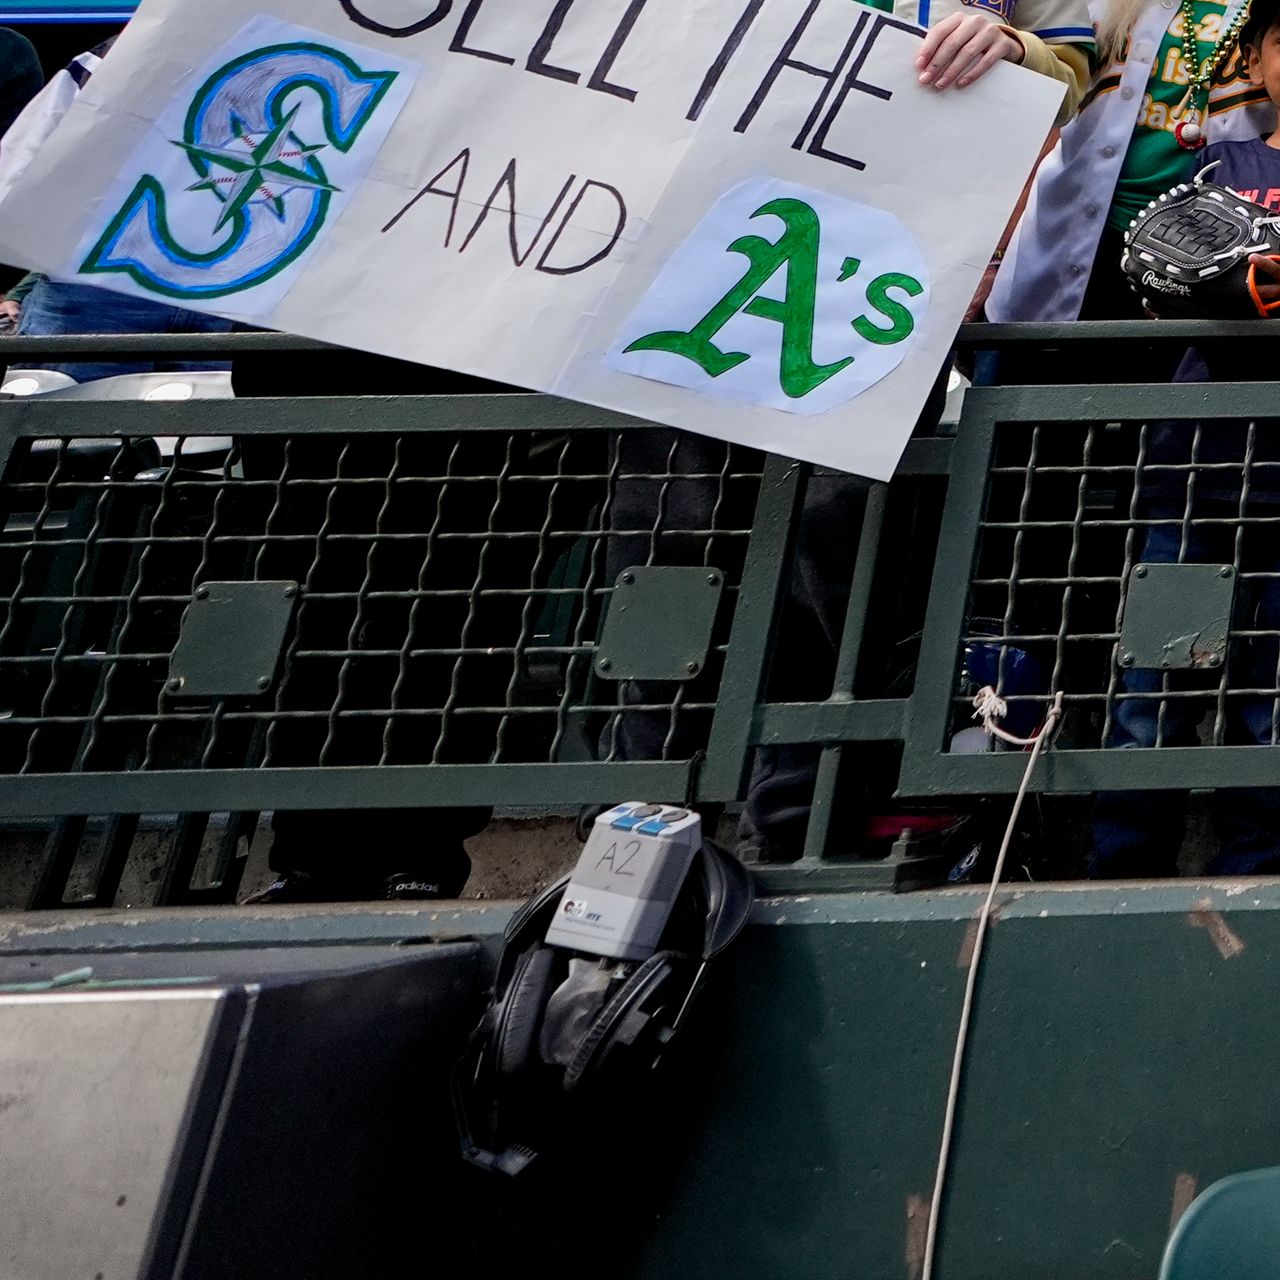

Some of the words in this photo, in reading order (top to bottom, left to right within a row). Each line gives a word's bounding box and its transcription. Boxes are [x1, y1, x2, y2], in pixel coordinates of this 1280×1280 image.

[381, 146, 627, 276] AND
[622, 197, 925, 399] A's
[1142, 270, 1191, 297] Rawlings
[594, 839, 642, 877] A2
[395, 880, 439, 894] adidas
